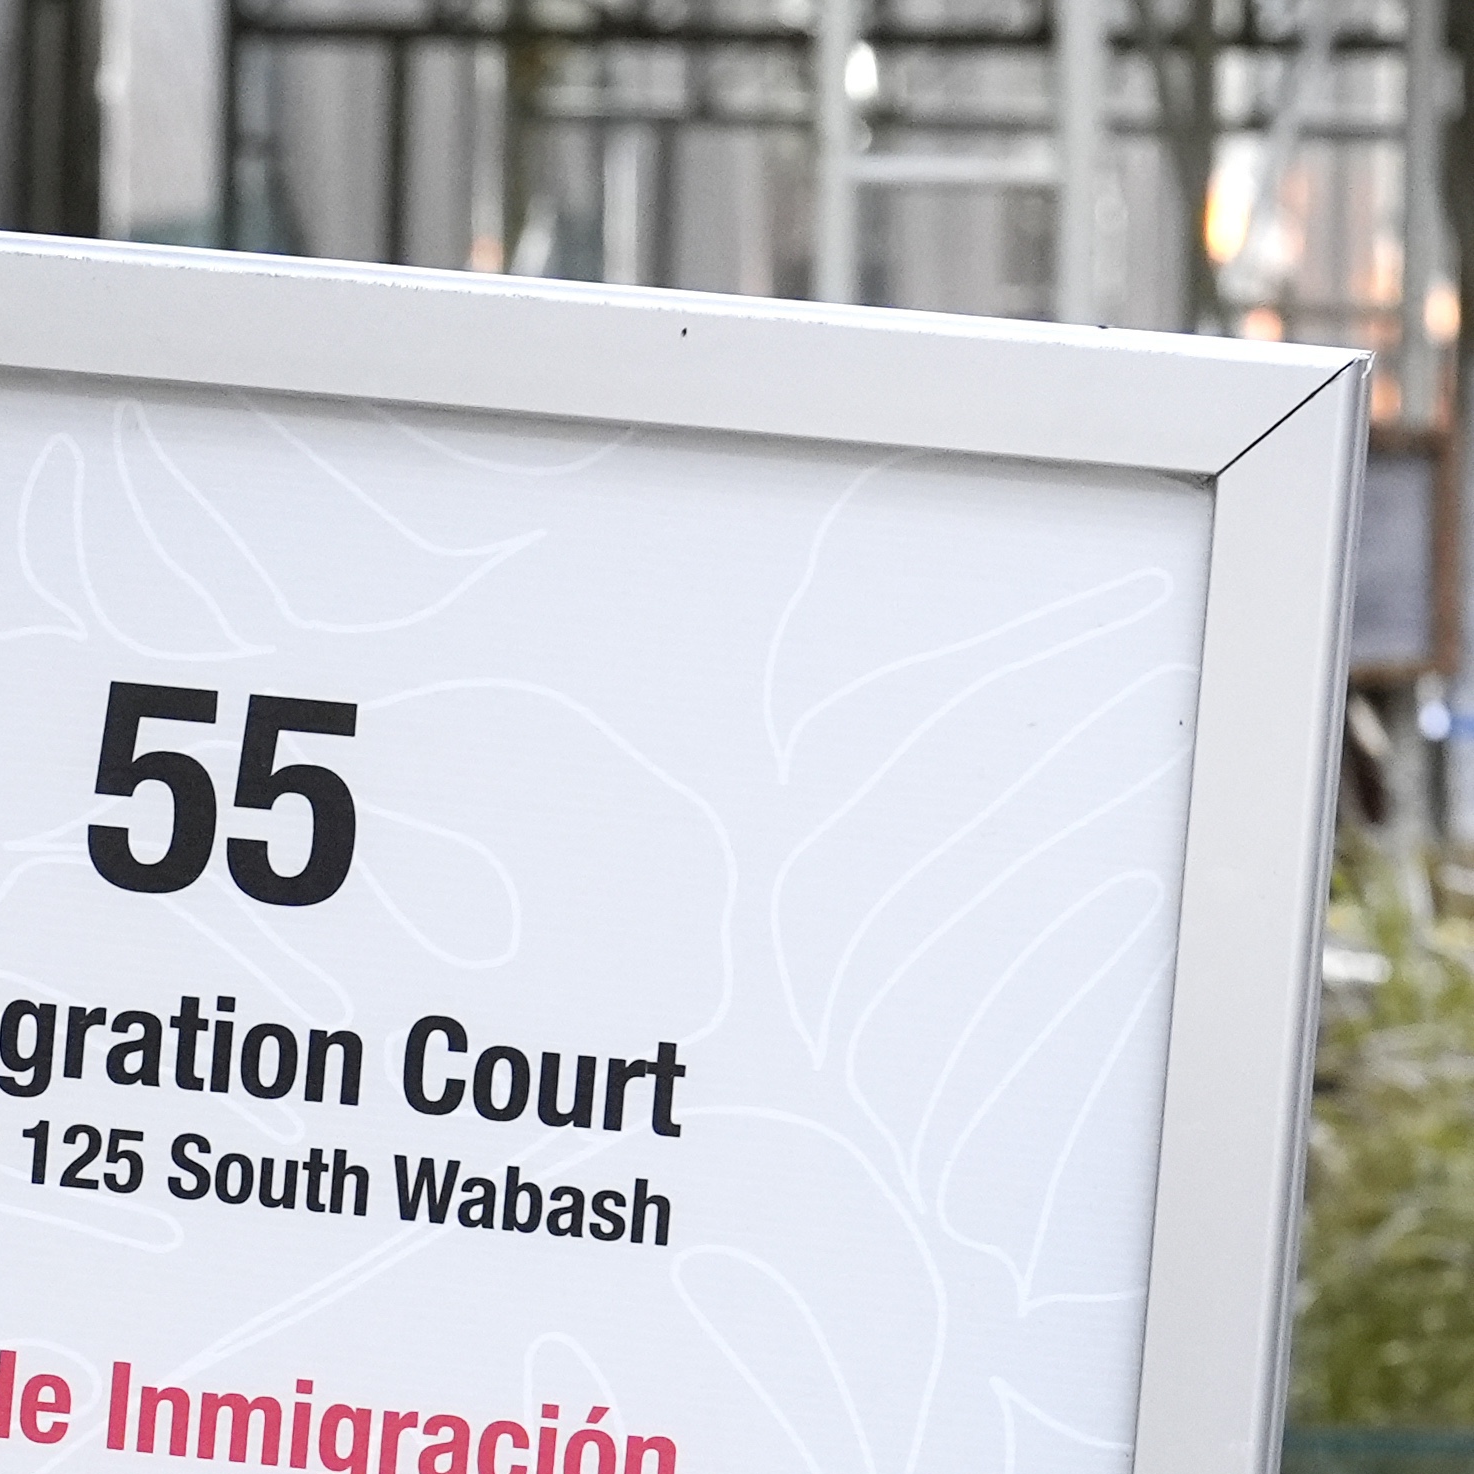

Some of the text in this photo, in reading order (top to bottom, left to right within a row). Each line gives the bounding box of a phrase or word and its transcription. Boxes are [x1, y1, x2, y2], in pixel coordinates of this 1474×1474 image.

[87, 680, 358, 907] 55
[402, 1014, 687, 1138] Court
[22, 1119, 145, 1194] 125
[167, 1132, 370, 1217] South
[393, 1154, 671, 1247] Wabash
